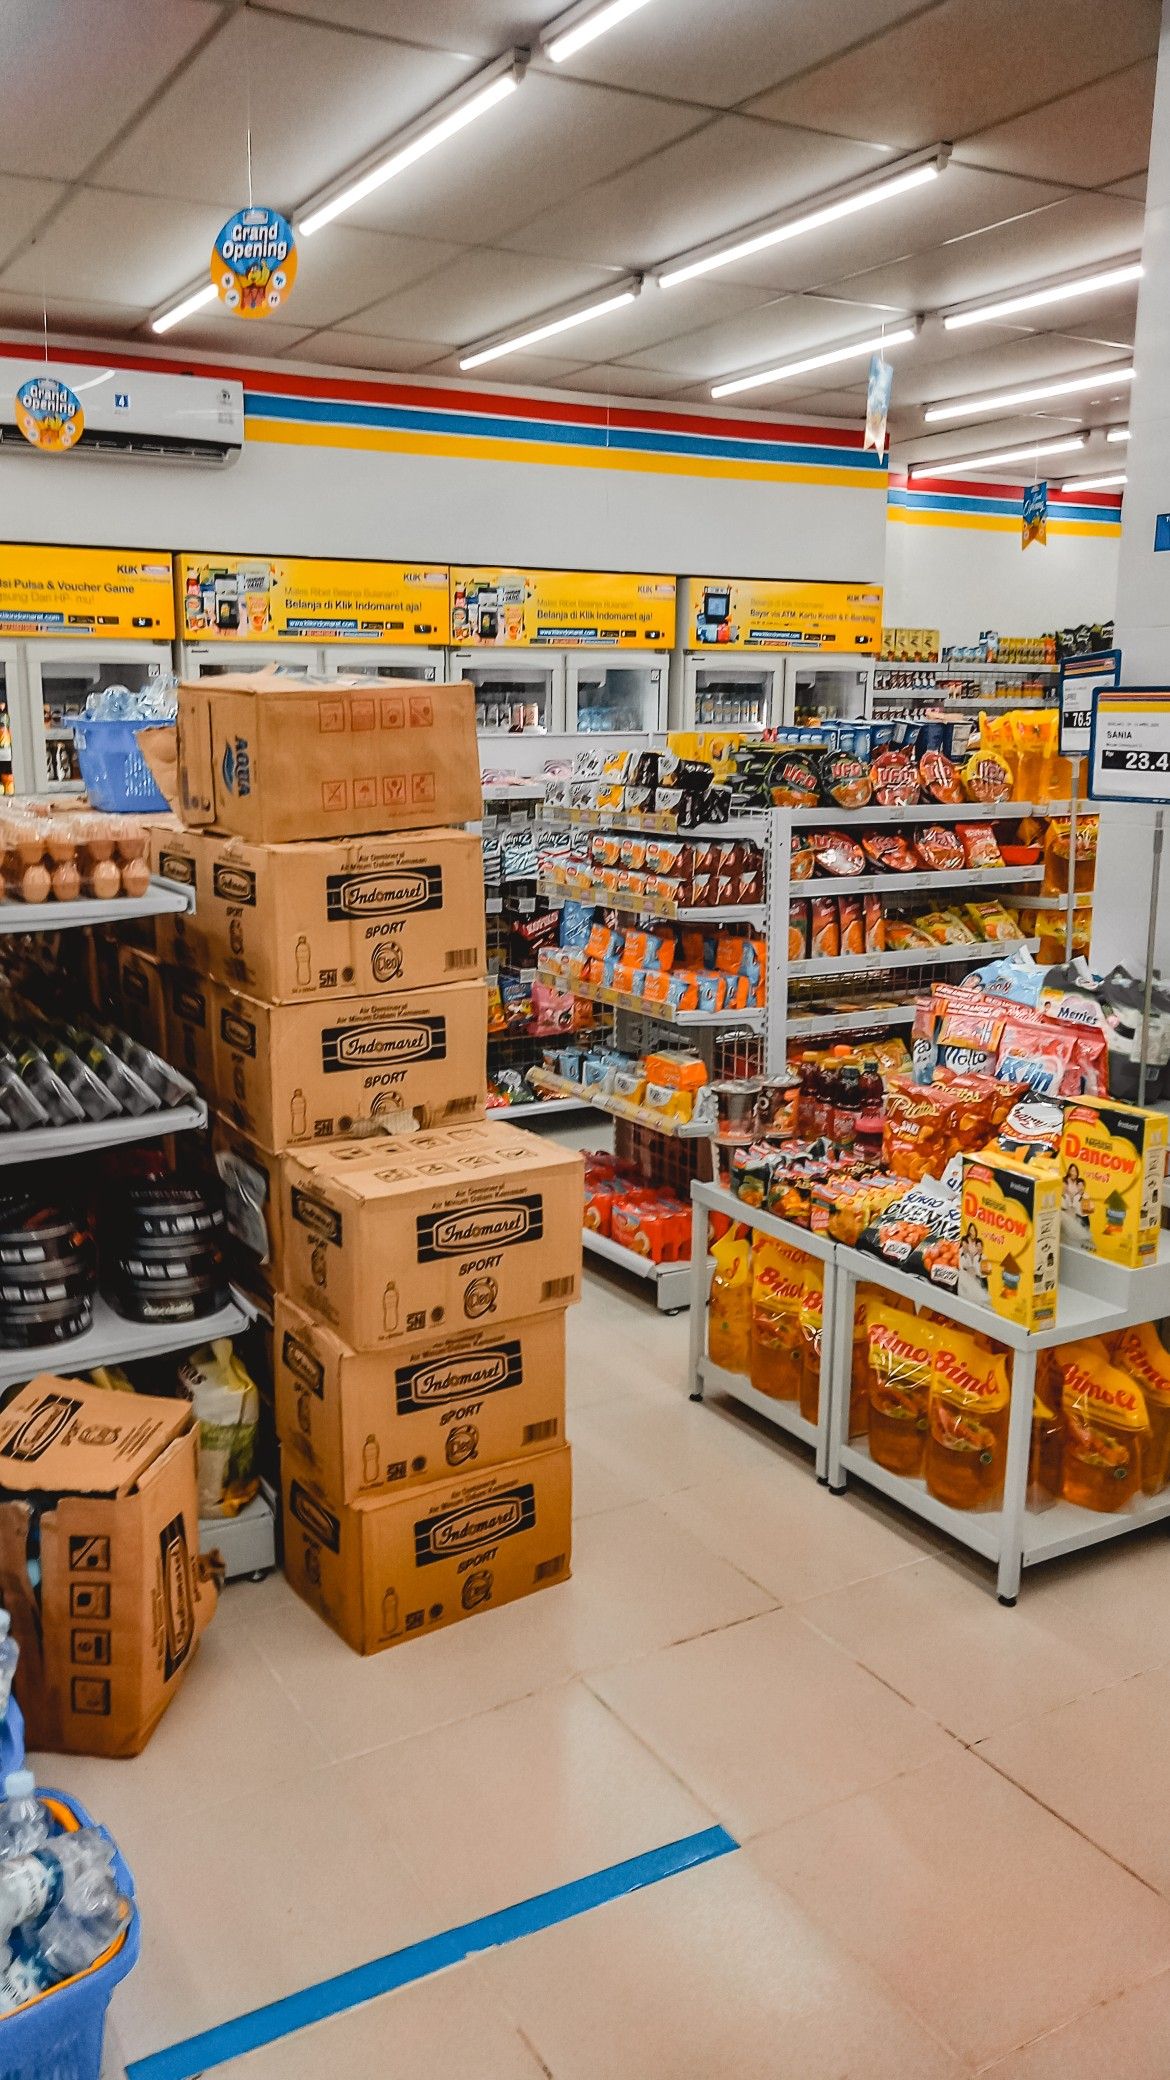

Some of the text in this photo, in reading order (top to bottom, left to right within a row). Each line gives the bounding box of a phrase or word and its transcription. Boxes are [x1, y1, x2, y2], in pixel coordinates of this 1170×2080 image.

[232, 221, 279, 242] Grand
[222, 240, 288, 263] Opening
[30, 385, 68, 401] Grand
[22, 396, 76, 415] Opening
[14, 579, 44, 591] Pulsa
[47, 581, 55, 590] &
[58, 581, 101, 593] Voucher
[104, 584, 135, 594] Game
[285, 599, 422, 613] Belanja di Klik Indomaret aja!
[537, 610, 653, 622] Belanja di Klik Indomaret aja!
[750, 609, 770, 619] Bayar
[1106, 730, 1132, 739] SANIA
[235, 735, 250, 797] AQUA
[349, 882, 422, 906] Indomaret
[364, 920, 407, 939] SPORT
[1057, 1006, 1100, 1026] Merries
[345, 1032, 425, 1057] Indomaret
[945, 1046, 987, 1066] Molto
[364, 1070, 409, 1089] SPORT
[1065, 1132, 1137, 1175] Dancow
[964, 1191, 1028, 1238] Dancow
[441, 1213, 521, 1244] Indomaret
[459, 1253, 504, 1277] SPORT
[420, 1362, 500, 1395] Indomaret
[440, 1402, 484, 1427] SPORT
[439, 1506, 515, 1544] Indomaret
[457, 1547, 499, 1574] SPORT
